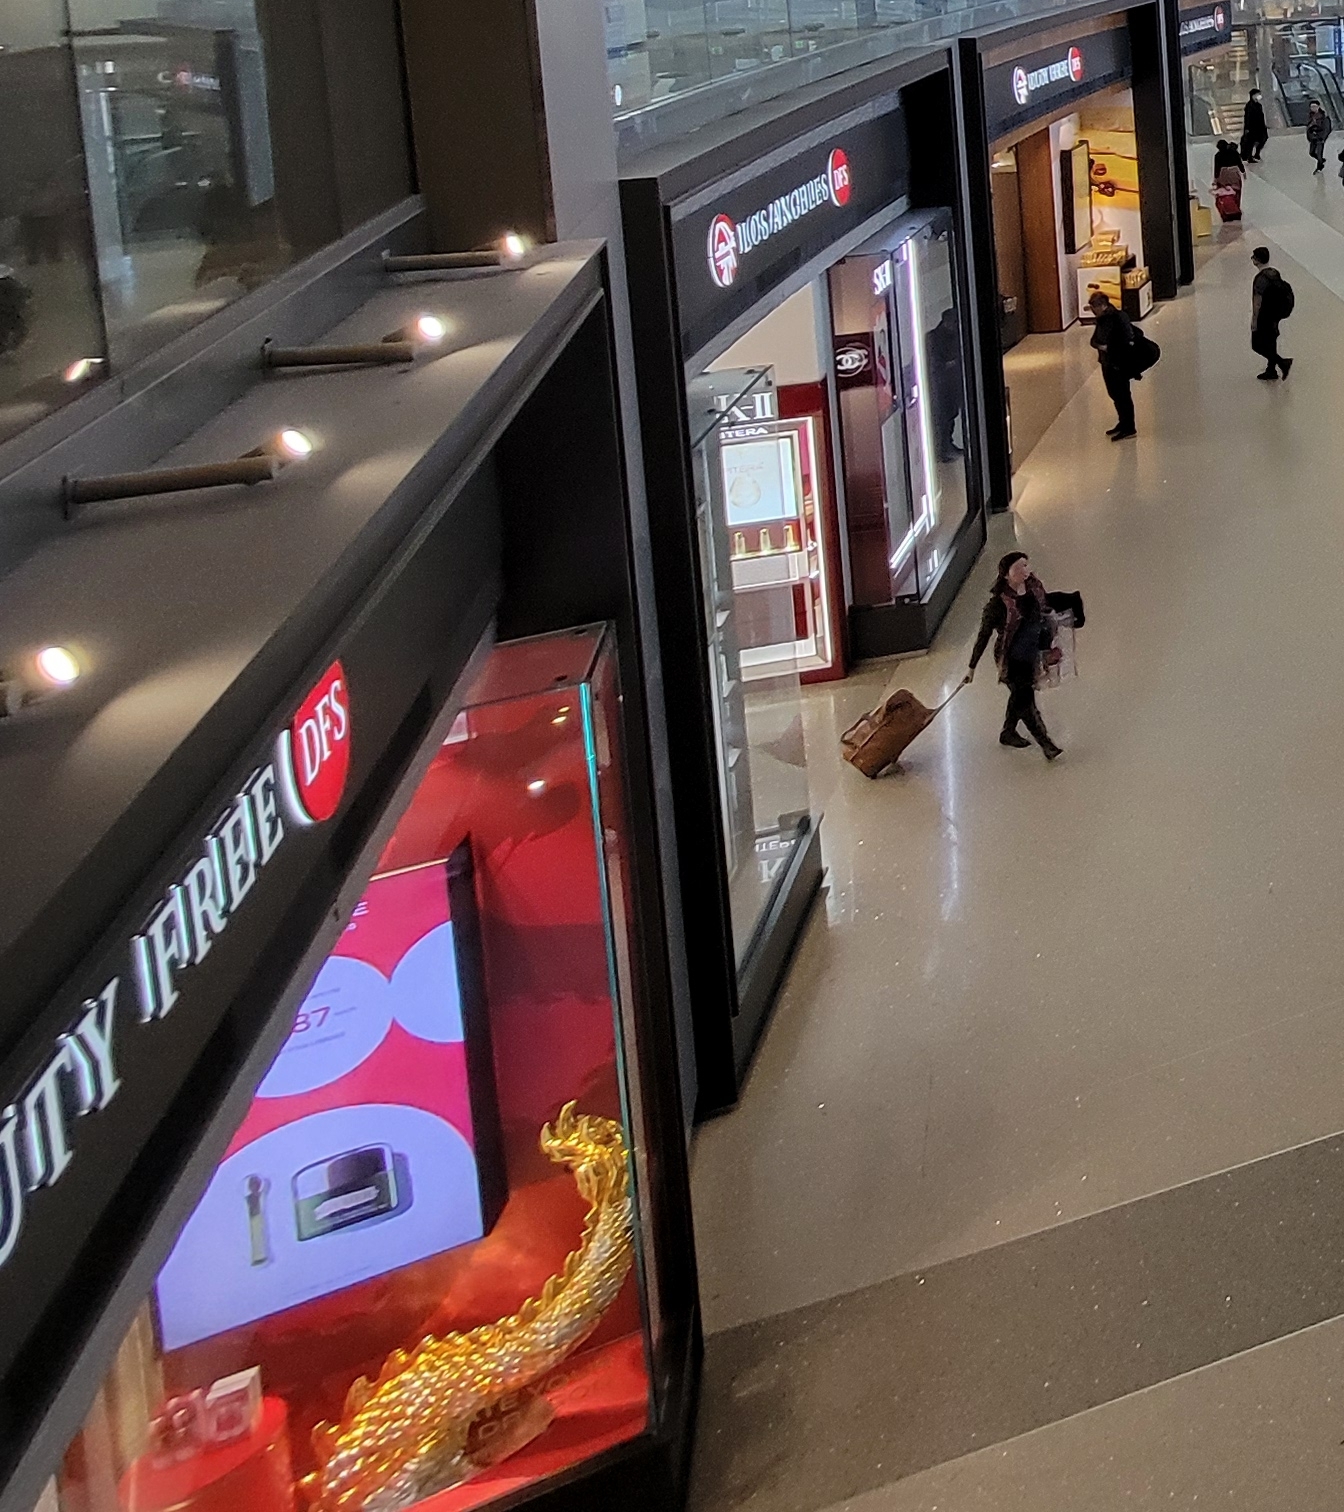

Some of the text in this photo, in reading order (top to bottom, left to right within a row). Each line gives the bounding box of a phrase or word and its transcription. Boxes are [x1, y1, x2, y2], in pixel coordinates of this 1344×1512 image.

[833, 164, 850, 191] DFS
[131, 763, 284, 1022] FREE
[299, 678, 348, 787] DFS
